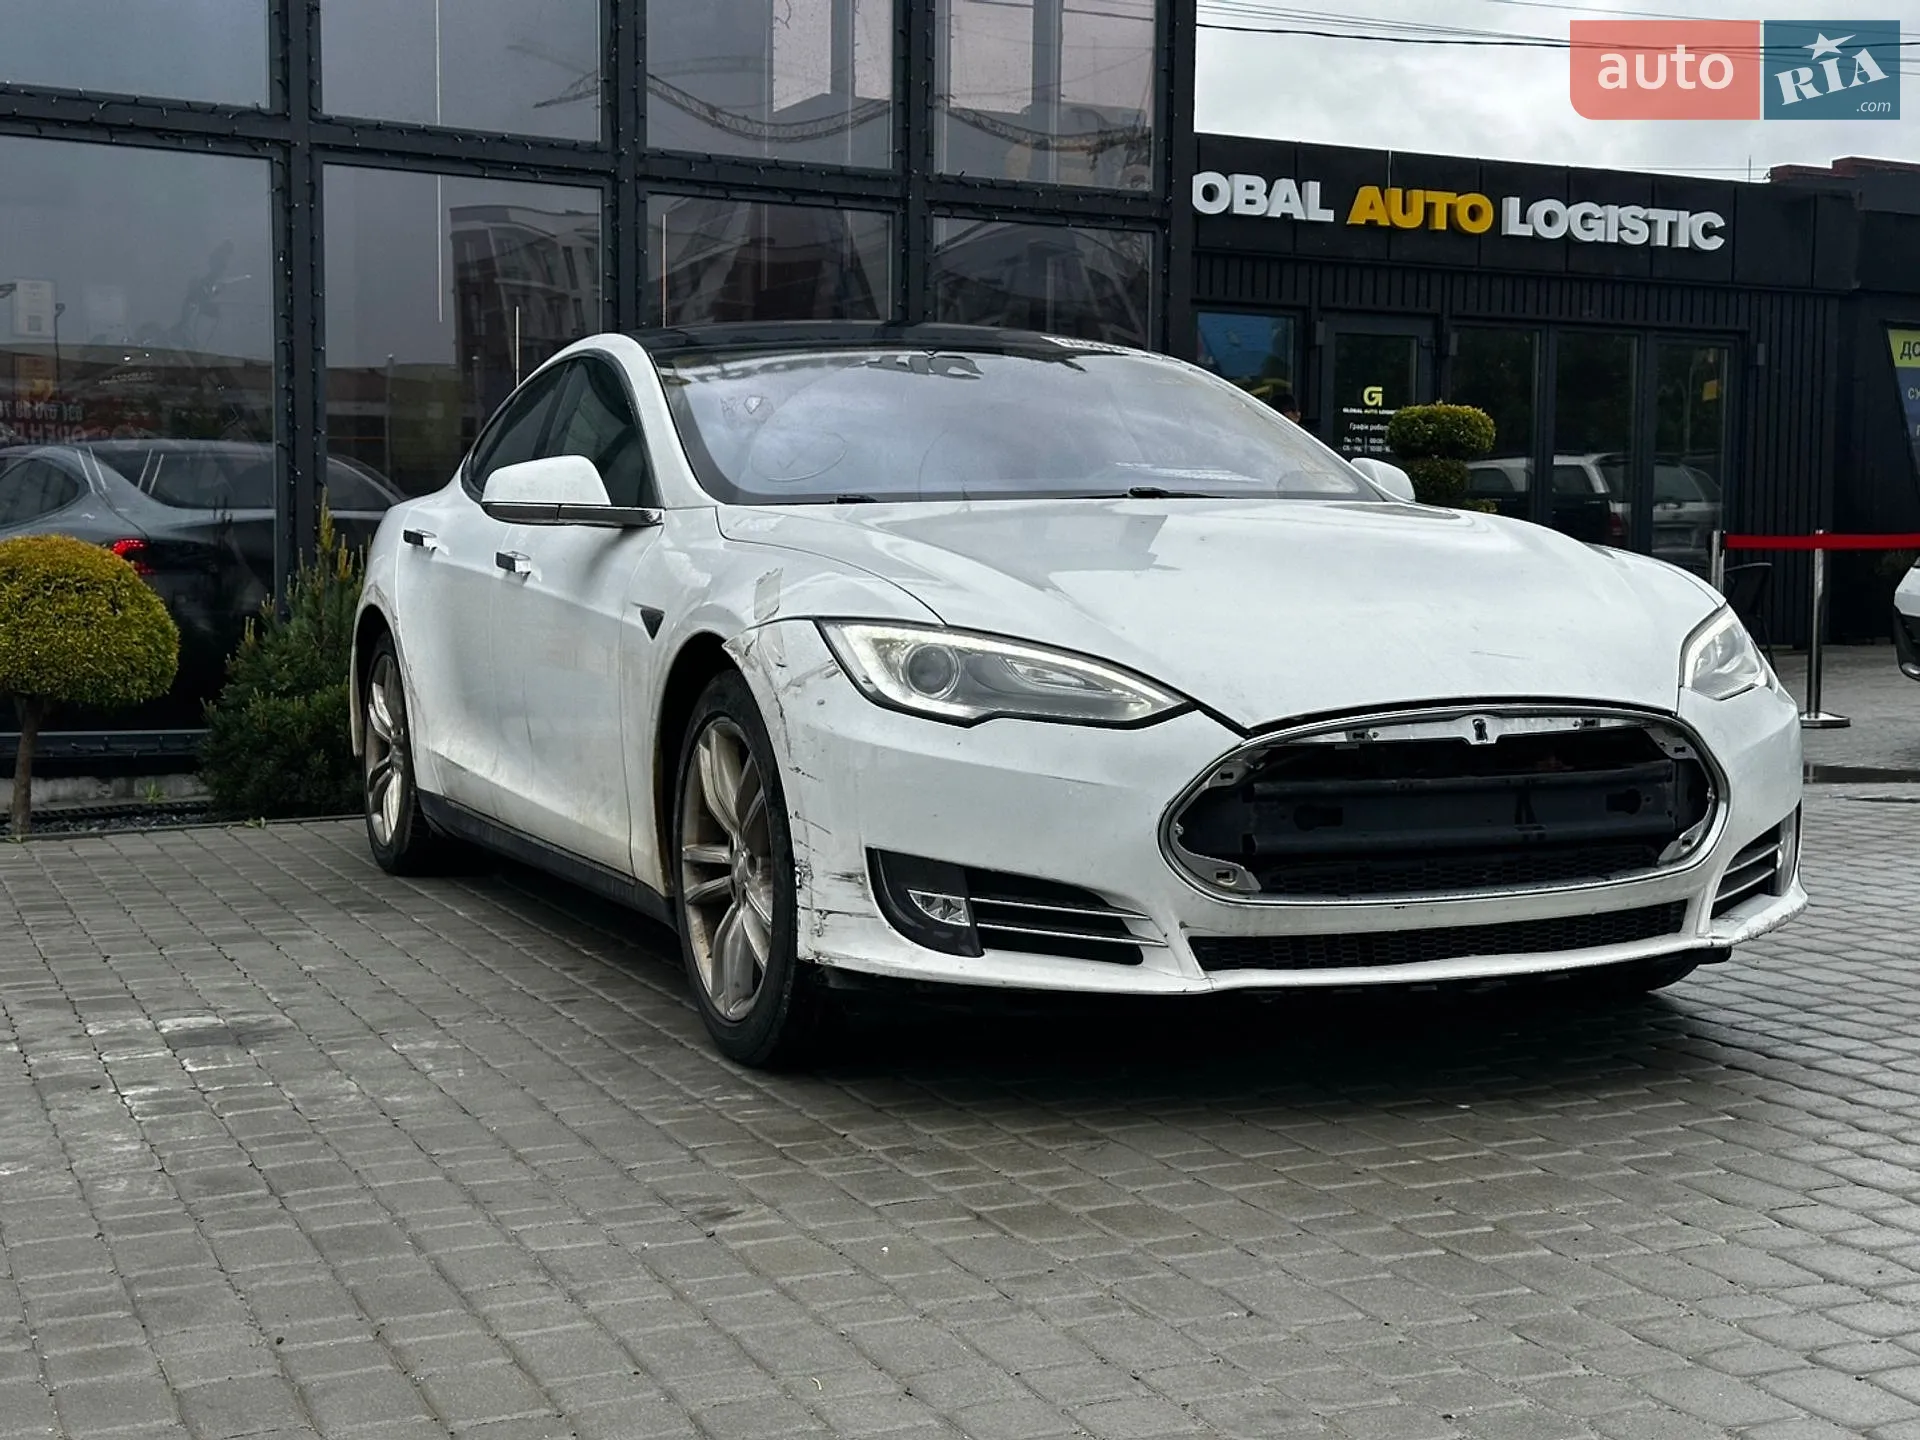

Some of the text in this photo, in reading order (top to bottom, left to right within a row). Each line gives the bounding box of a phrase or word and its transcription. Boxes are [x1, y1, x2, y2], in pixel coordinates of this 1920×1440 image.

[1192, 171, 1725, 251] OBAL AUTO LOGISTIC
